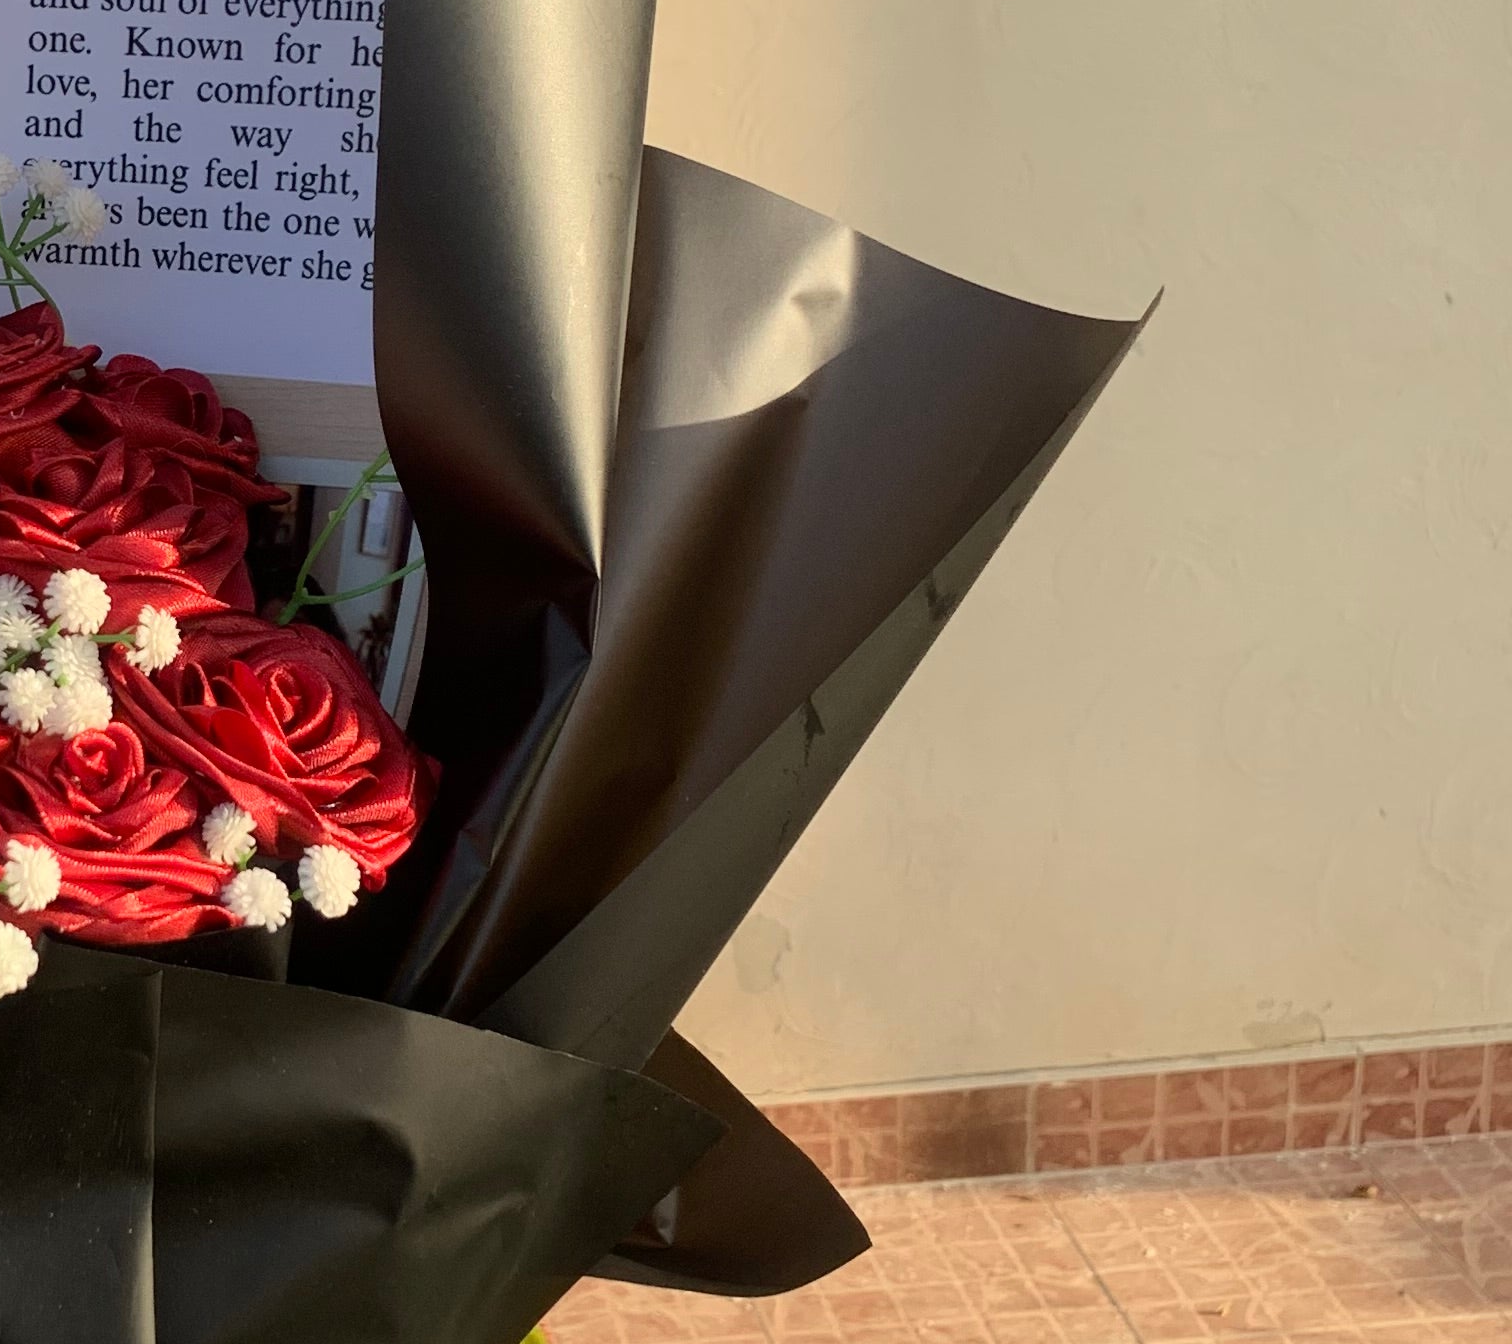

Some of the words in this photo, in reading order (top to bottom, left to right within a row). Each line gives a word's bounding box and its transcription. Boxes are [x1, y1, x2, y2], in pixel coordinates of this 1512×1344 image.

[29, 31, 91, 54] one.
[125, 26, 243, 61] Known
[274, 32, 321, 64] for
[26, 64, 96, 102] love,
[122, 68, 174, 100] her
[197, 75, 376, 118] comforting
[25, 109, 83, 138] and
[133, 112, 181, 143] the
[231, 126, 292, 156] way
[21, 154, 190, 192] rything
[204, 158, 258, 189] feel
[275, 162, 359, 201] right,
[137, 196, 208, 228] been
[223, 201, 270, 232] the
[284, 214, 339, 236] one
[20, 235, 142, 268] warmth
[152, 241, 292, 277] wherever
[302, 250, 351, 281] she
